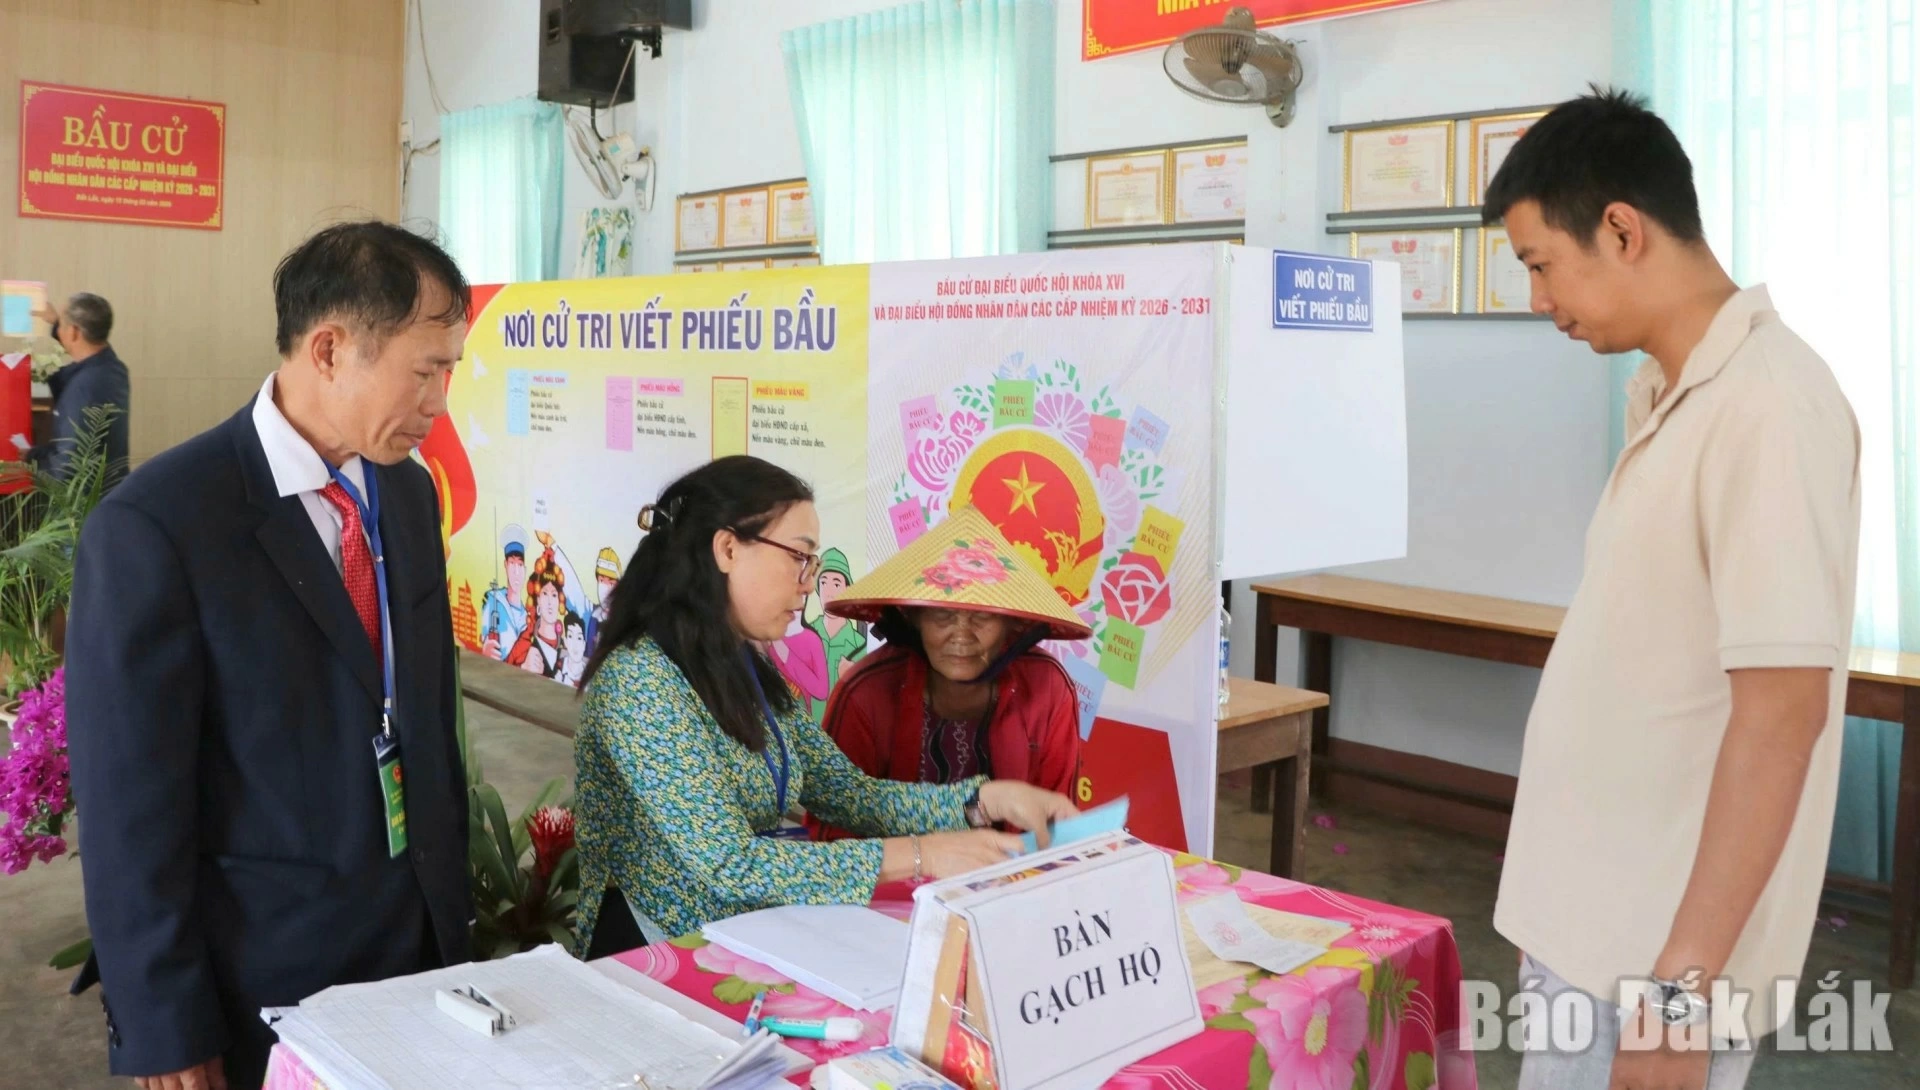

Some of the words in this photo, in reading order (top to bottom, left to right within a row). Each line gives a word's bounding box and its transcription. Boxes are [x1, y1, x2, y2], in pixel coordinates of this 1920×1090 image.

[62, 104, 133, 151] BẦU
[141, 115, 189, 156] CỬ
[974, 279, 992, 298] ĐẠI
[1020, 272, 1048, 295] QUỐC
[1051, 272, 1070, 295] HỘI
[1072, 272, 1103, 292] KHÓA
[1106, 274, 1125, 291] XVI
[1294, 268, 1314, 290] NƠI
[1318, 265, 1335, 291] CỬ
[1336, 272, 1355, 292] TRI
[504, 309, 535, 347] NƠI
[542, 300, 571, 348] CỬ
[576, 314, 612, 349] TRI
[620, 296, 672, 350] VIẾT
[682, 292, 762, 350] PHIẾU
[774, 288, 836, 352] BẦU
[874, 304, 886, 320] VÀ
[888, 305, 903, 324] ĐẠI
[928, 301, 944, 323] HỘI
[975, 300, 1004, 319] NHÂN
[1006, 299, 1028, 318] DÂN
[1031, 298, 1052, 318] CÁC
[1056, 295, 1078, 317] CẤP
[1081, 296, 1118, 320] NHIỆM
[1121, 296, 1136, 316] KỲ
[1140, 299, 1169, 316] 2026
[1181, 297, 1211, 315] 2031
[1279, 293, 1307, 320] VIẾT
[1310, 296, 1344, 322] PHIẾU
[1346, 296, 1369, 322] BẦU
[1053, 908, 1113, 959] BÀN
[1019, 966, 1107, 1025] GẠCH
[1118, 941, 1162, 987] HỘ
